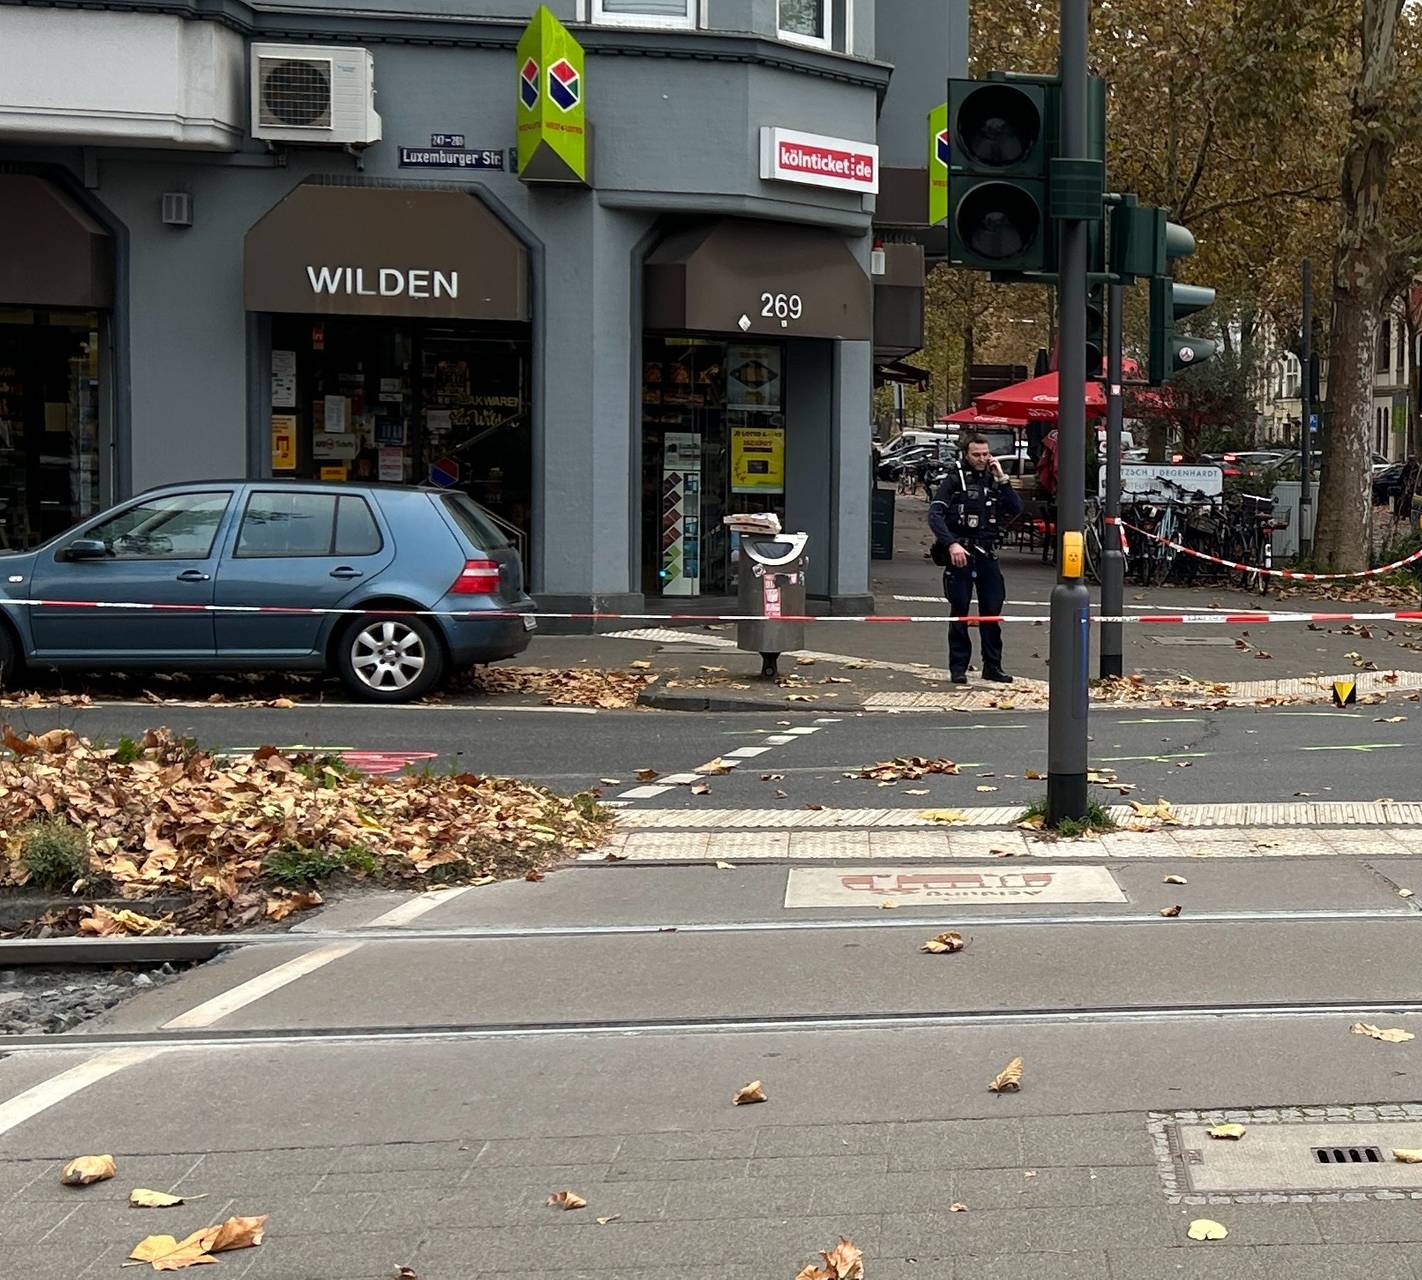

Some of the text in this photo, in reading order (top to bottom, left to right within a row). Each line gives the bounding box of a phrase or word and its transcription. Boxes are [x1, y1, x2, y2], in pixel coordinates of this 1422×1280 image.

[402, 149, 478, 167] Luxemburger
[306, 266, 458, 299] WILDEN
[760, 292, 802, 319] 269
[1159, 469, 1218, 477] DEGENHARDT
